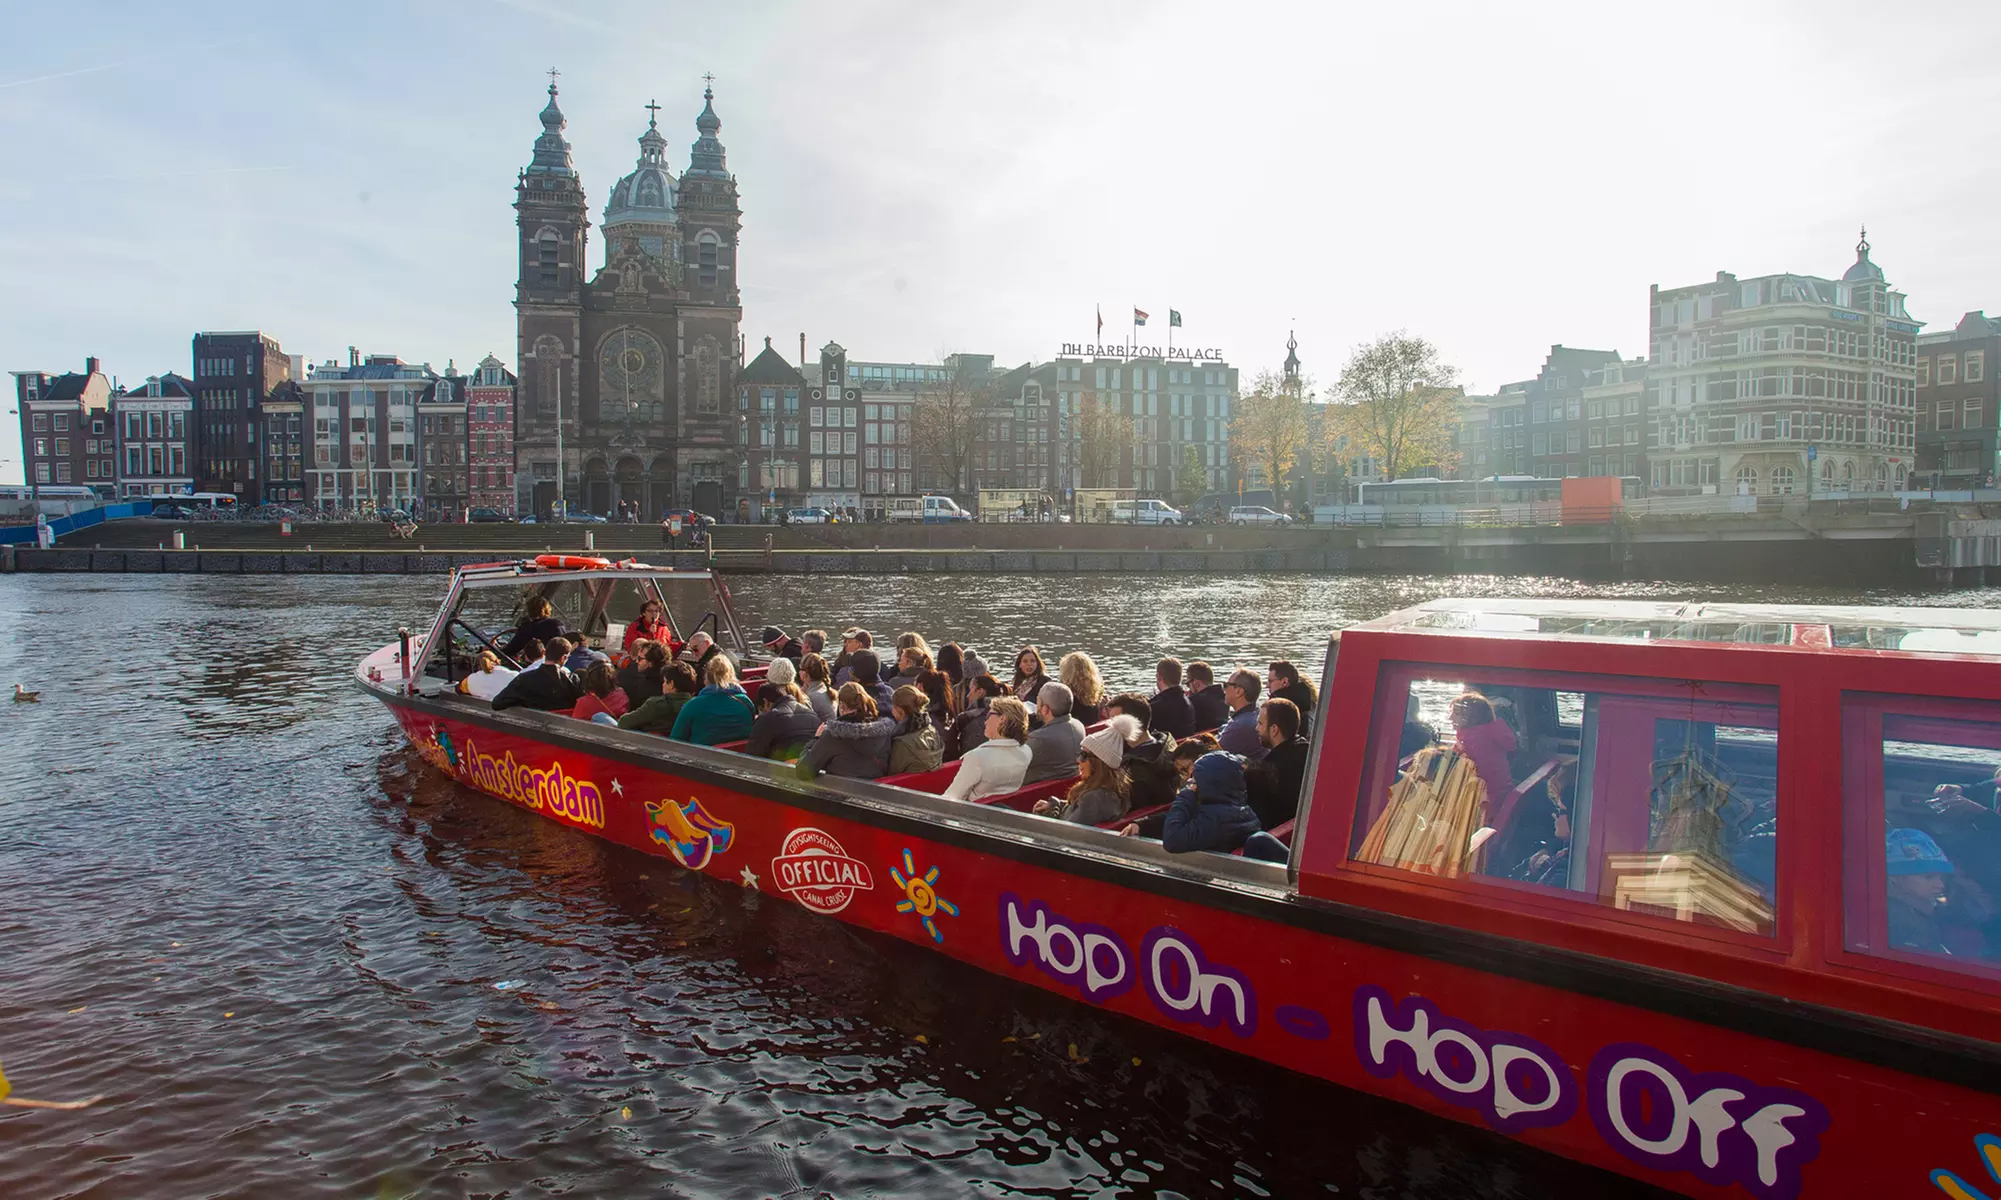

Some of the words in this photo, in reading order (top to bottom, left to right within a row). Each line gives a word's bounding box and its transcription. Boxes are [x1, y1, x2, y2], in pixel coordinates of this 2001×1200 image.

[1087, 344, 1162, 357] BARBIZON
[1169, 347, 1222, 359] PALACE
[467, 738, 605, 829] Amsterdam
[781, 859, 867, 886] OFFICIAL
[802, 890, 828, 908] CANAL
[826, 888, 847, 908] CRUISE
[1149, 934, 1248, 1028] On
